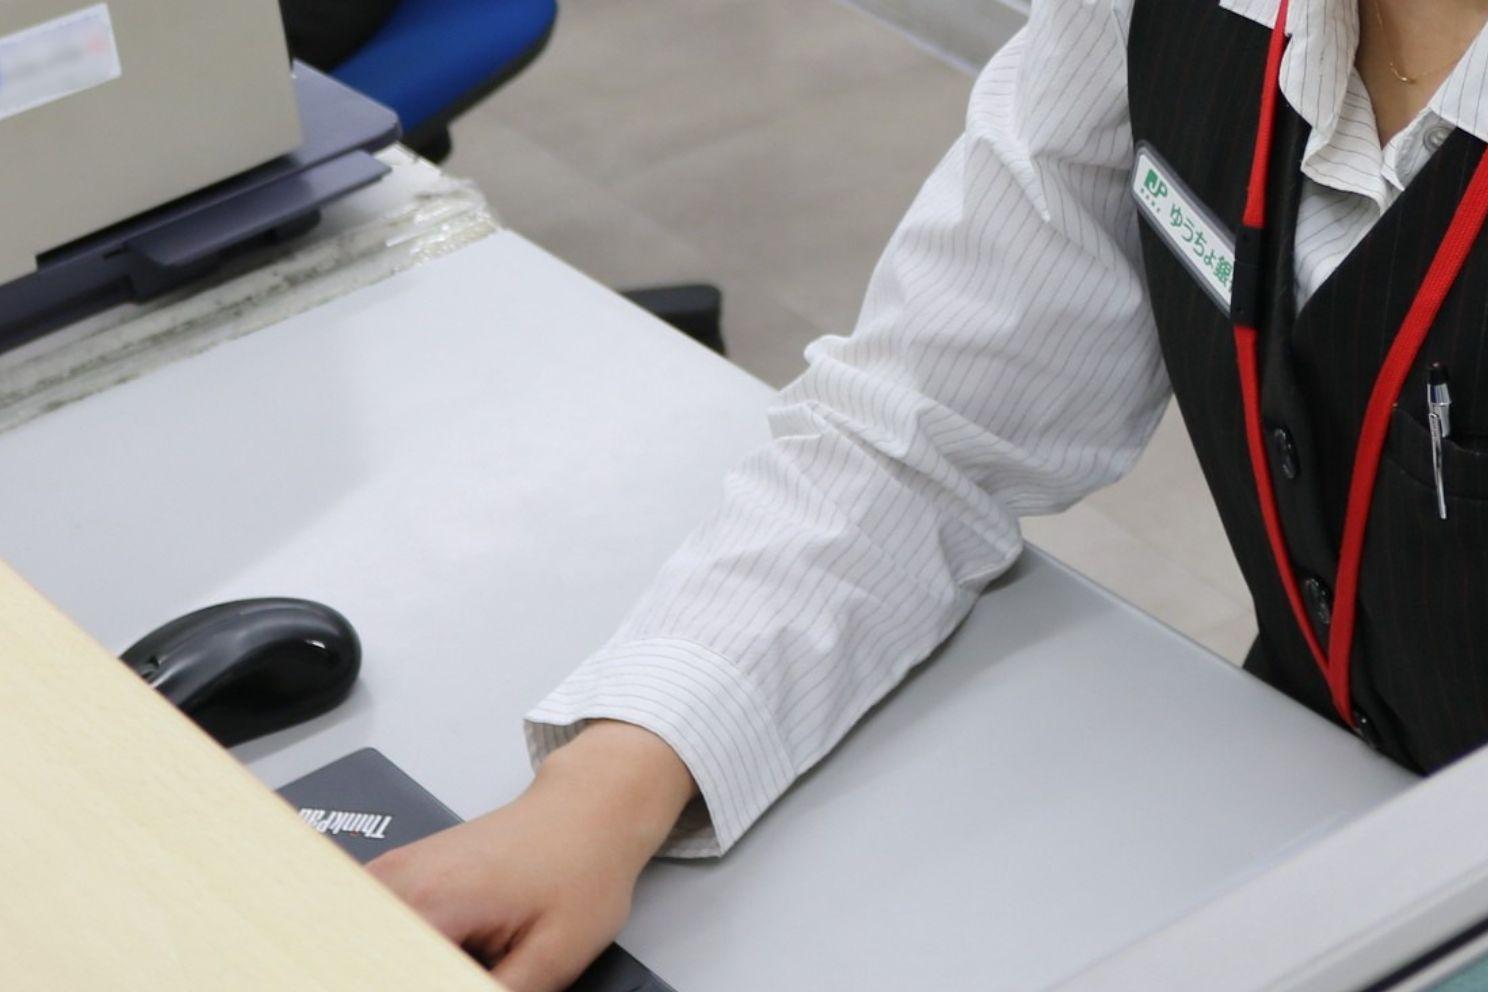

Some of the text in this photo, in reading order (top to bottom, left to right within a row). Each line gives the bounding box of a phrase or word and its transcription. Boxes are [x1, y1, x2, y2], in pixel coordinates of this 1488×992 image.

[1169, 203, 1233, 293] ゆうちょ銀
